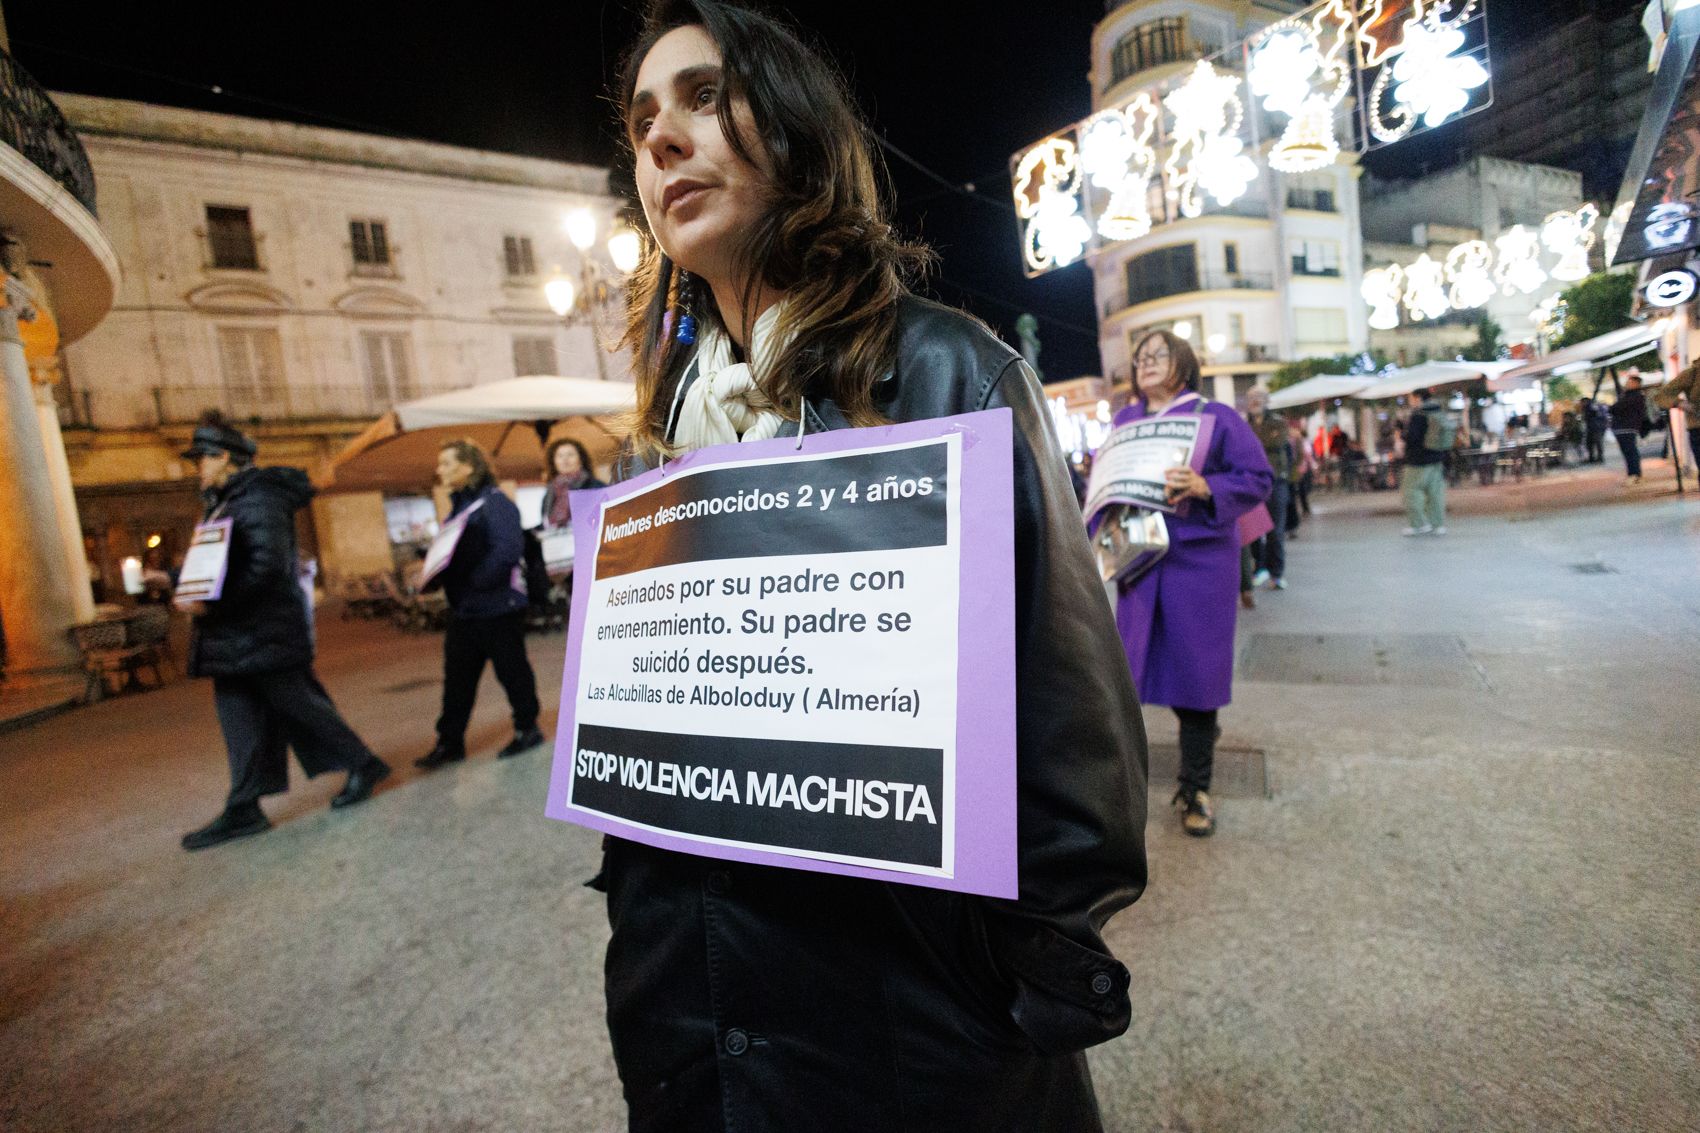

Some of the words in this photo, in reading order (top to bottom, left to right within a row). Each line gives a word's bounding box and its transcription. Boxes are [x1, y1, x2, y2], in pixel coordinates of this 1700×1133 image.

[604, 514, 653, 544] Nombres
[653, 488, 790, 528] desconocidos
[796, 485, 813, 508] 2
[820, 487, 836, 511] y
[842, 481, 858, 504] 4
[866, 475, 934, 502] años
[606, 580, 676, 609] Aseinados
[680, 577, 715, 604] por
[722, 577, 751, 596] su
[759, 568, 840, 599] padre
[849, 569, 905, 592] con
[597, 612, 733, 641] envenenamiento.
[740, 609, 775, 634] Su
[783, 607, 867, 639] padre
[876, 611, 912, 633] se
[632, 647, 691, 674] suicidó
[696, 646, 814, 680] después.
[587, 682, 606, 700] Las
[607, 683, 662, 704] Alcubillas
[666, 685, 686, 705] de
[689, 685, 795, 713] Alboloduy
[576, 748, 618, 783] STOP
[618, 755, 741, 804] VIOLENCIA
[746, 770, 938, 825] MACHISTA
